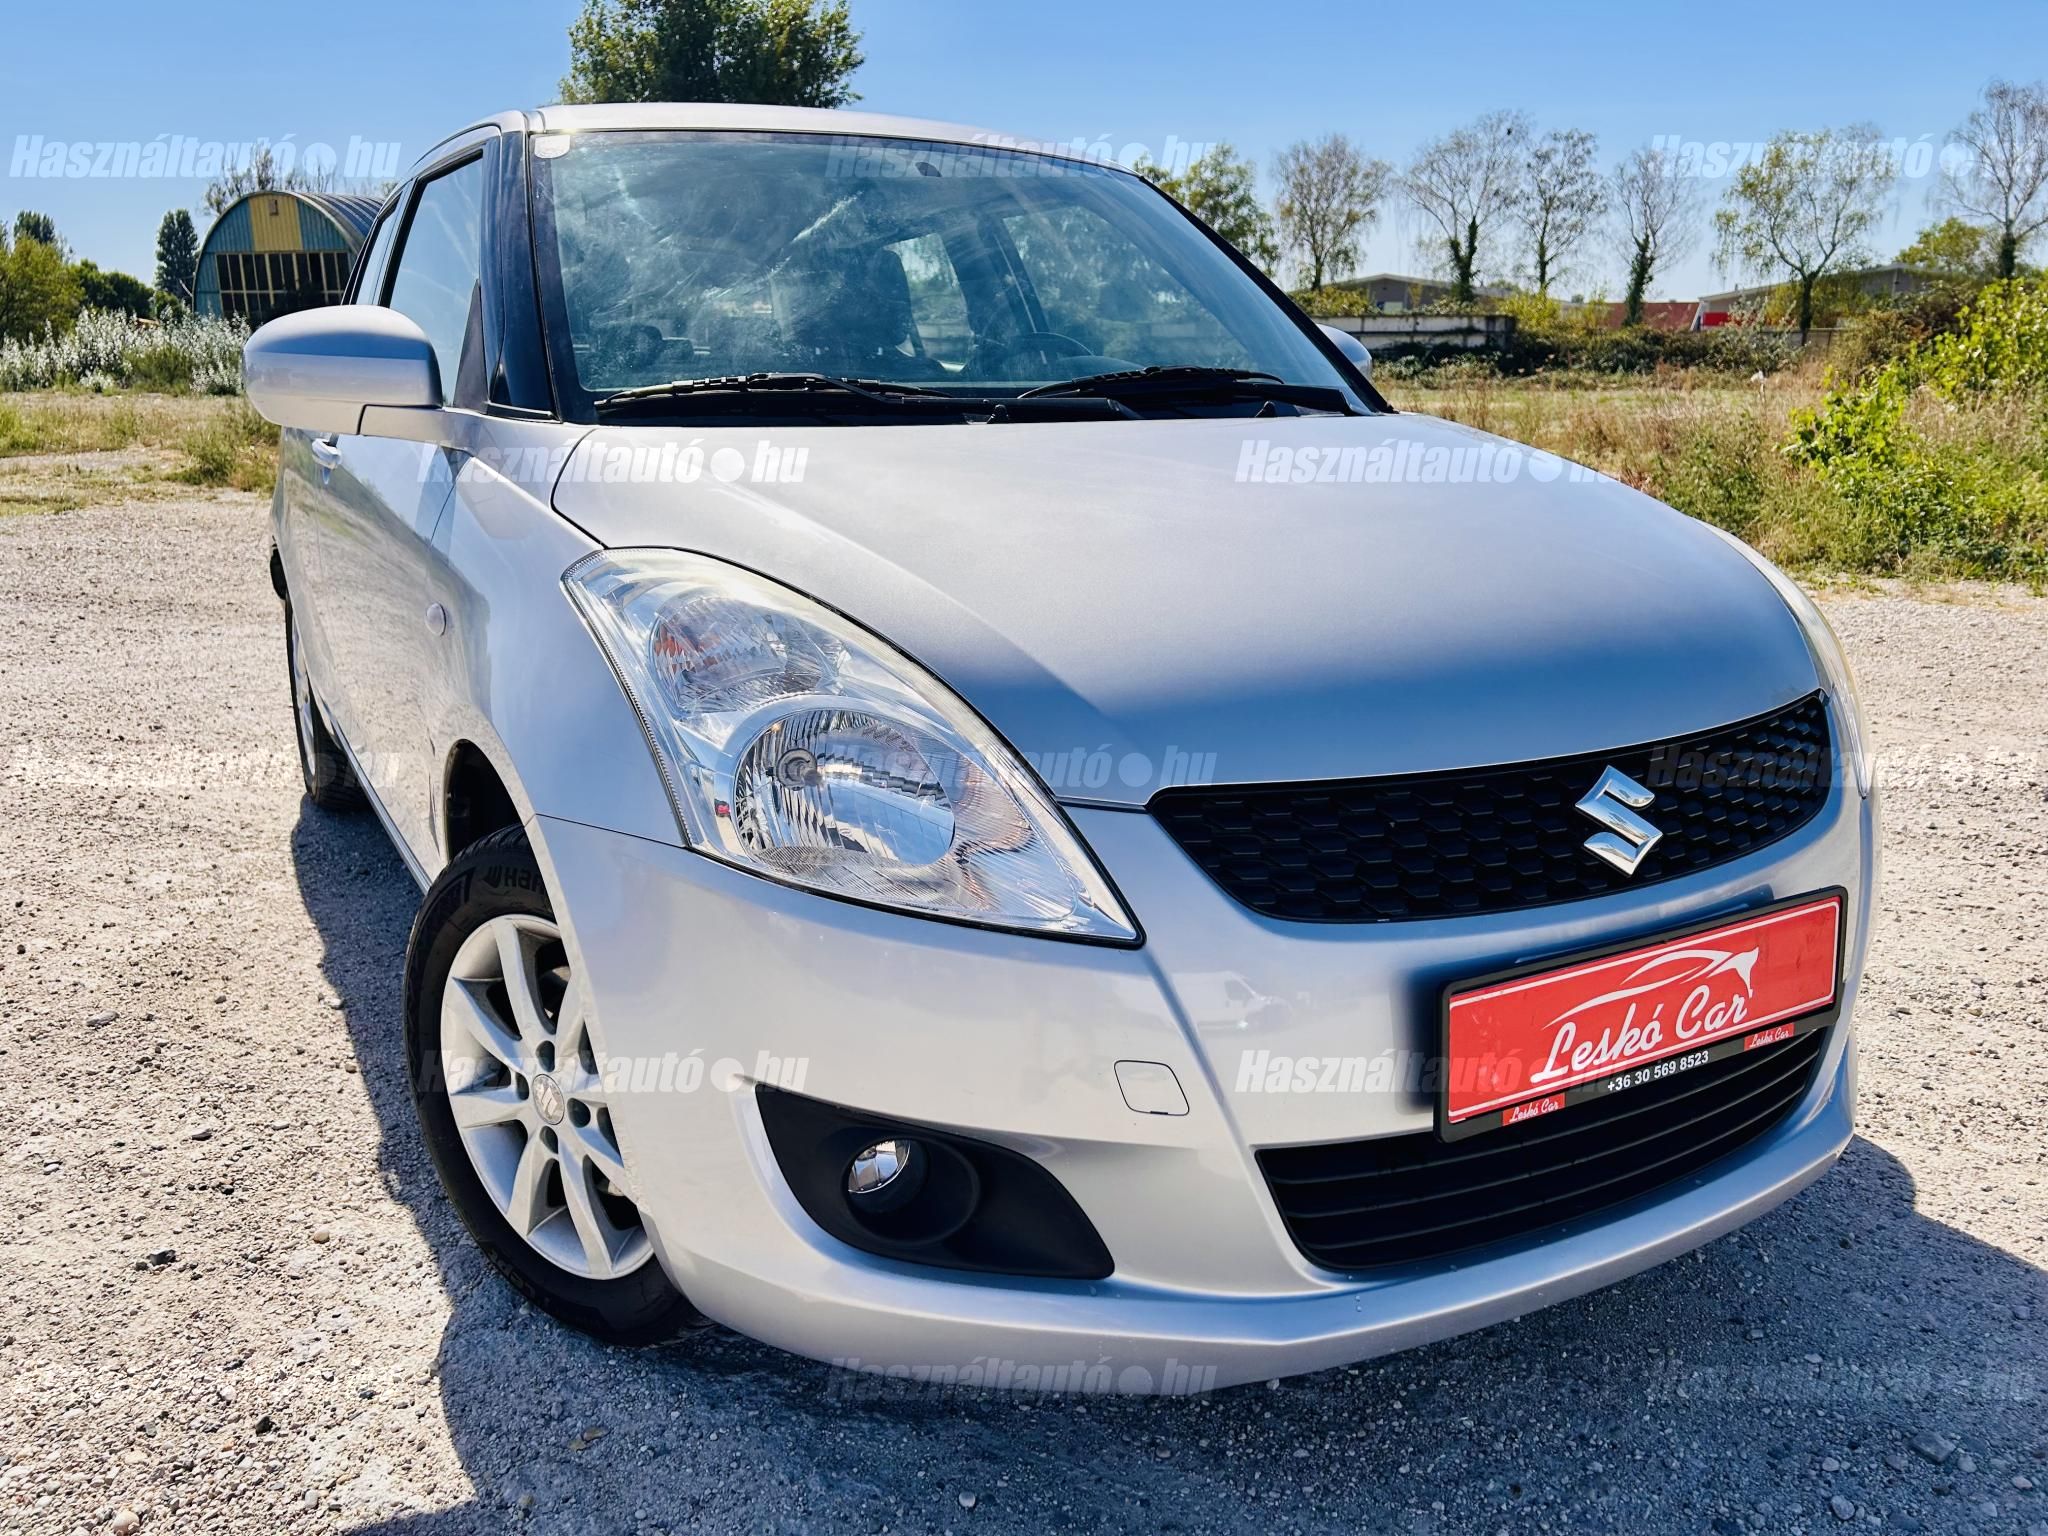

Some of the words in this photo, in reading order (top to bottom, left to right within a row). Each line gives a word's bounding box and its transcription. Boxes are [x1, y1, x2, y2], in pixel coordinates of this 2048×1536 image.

[1529, 1002, 1664, 1084] Leskó
[1675, 984, 1748, 1040] Car
[1774, 1027, 1790, 1041] Car
[1607, 1074, 1631, 1091] +36
[1634, 1068, 1651, 1085] 30
[1653, 1060, 1677, 1079] 569
[1679, 1050, 1710, 1071] 8523
[1540, 1098, 1560, 1113] Car
